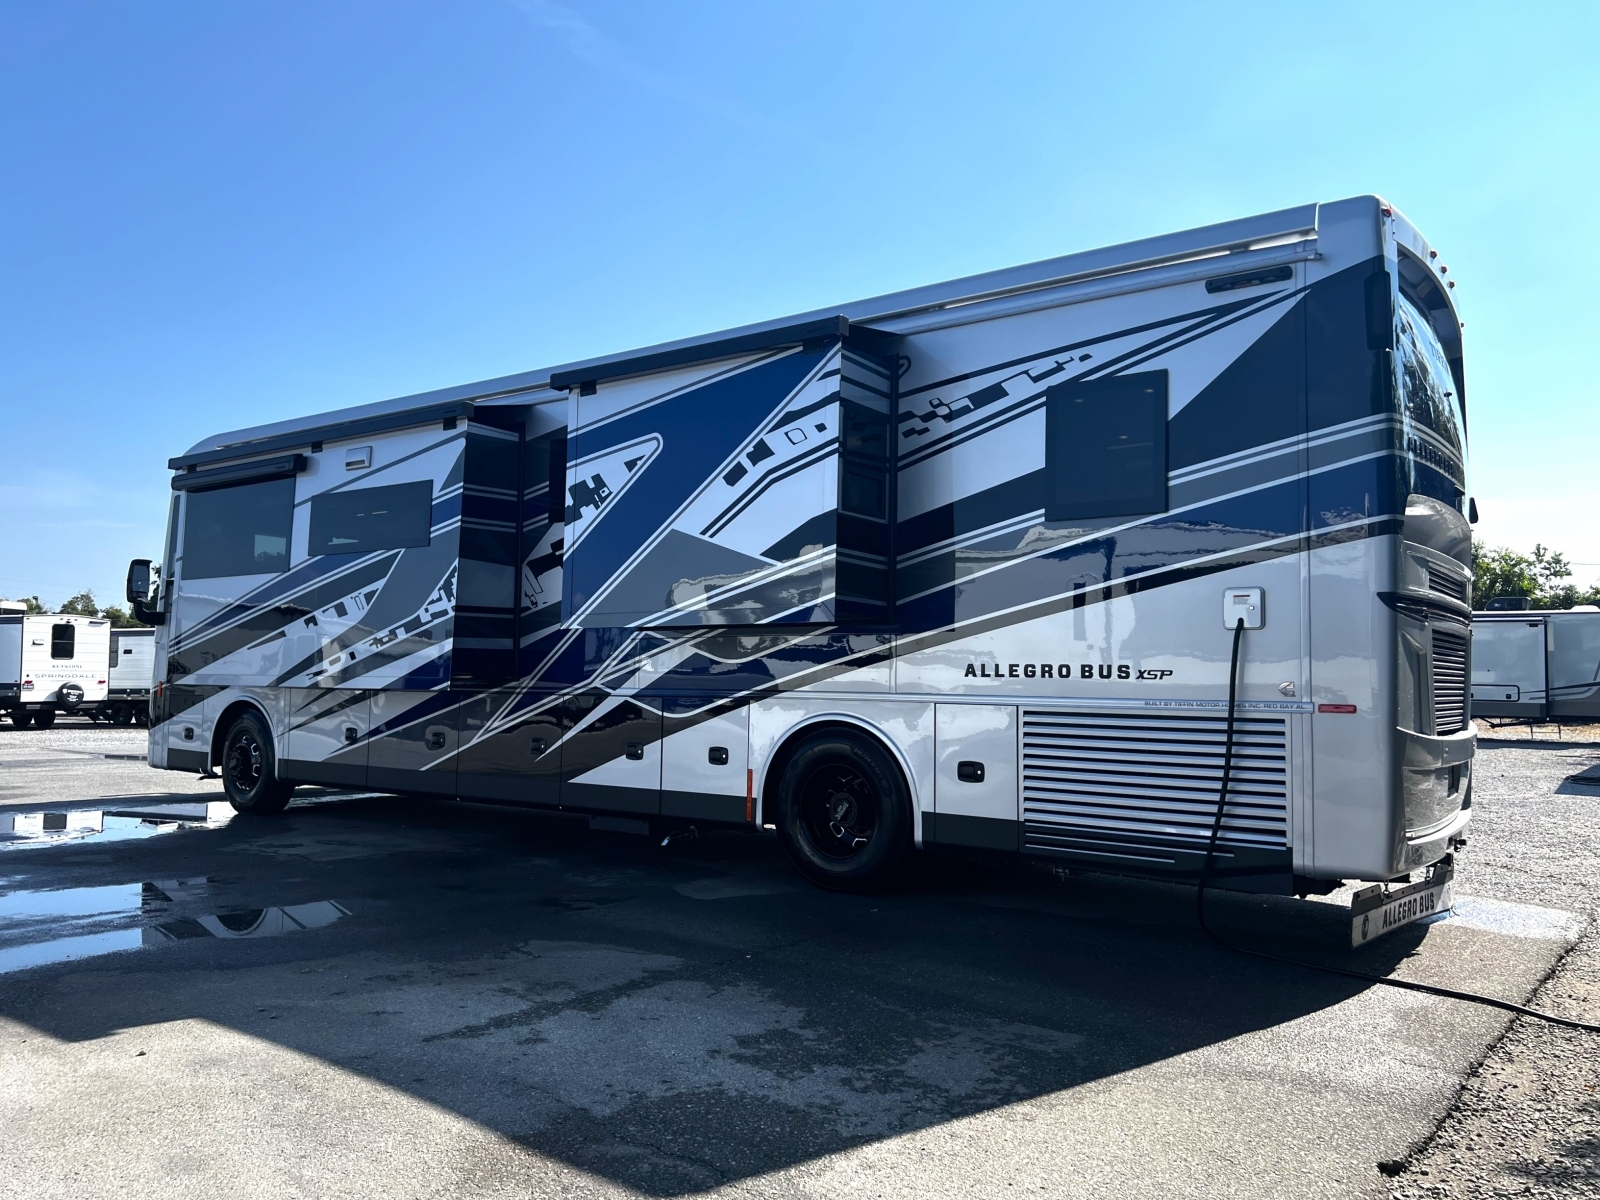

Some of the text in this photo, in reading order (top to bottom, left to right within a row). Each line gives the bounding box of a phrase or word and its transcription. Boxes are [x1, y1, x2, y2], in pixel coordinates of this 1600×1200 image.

[964, 663, 1174, 680] ALLEGRO BUS XSP
[1382, 892, 1434, 929] ALLEGRO BUS
